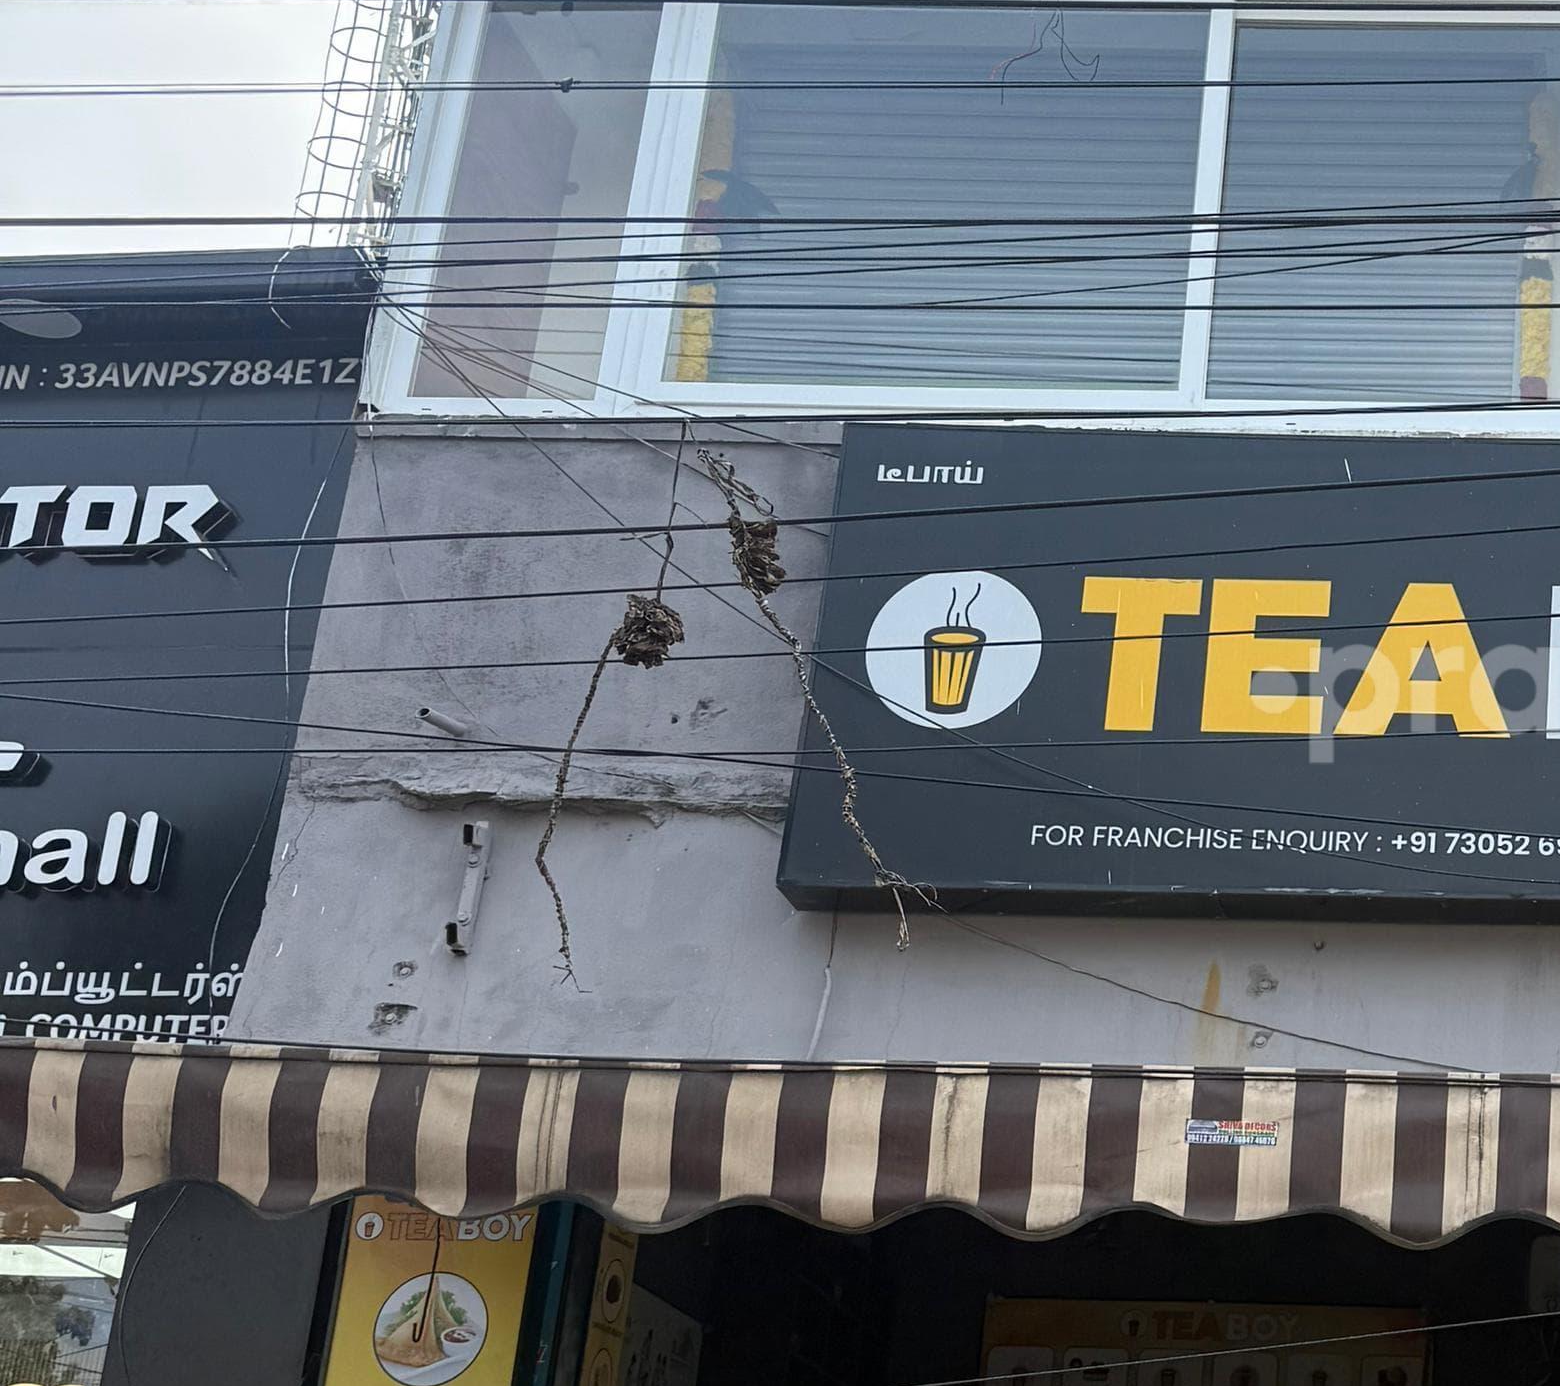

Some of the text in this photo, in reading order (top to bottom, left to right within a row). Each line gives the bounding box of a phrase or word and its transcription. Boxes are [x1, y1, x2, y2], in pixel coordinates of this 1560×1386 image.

[877, 460, 984, 485] டீபாய்
[1031, 825, 1084, 846] FOR
[1093, 826, 1243, 849] FRANCHISE
[1252, 830, 1369, 854] ENQUIRY
[1391, 832, 1437, 853] +91
[1445, 833, 1531, 855] 73052
